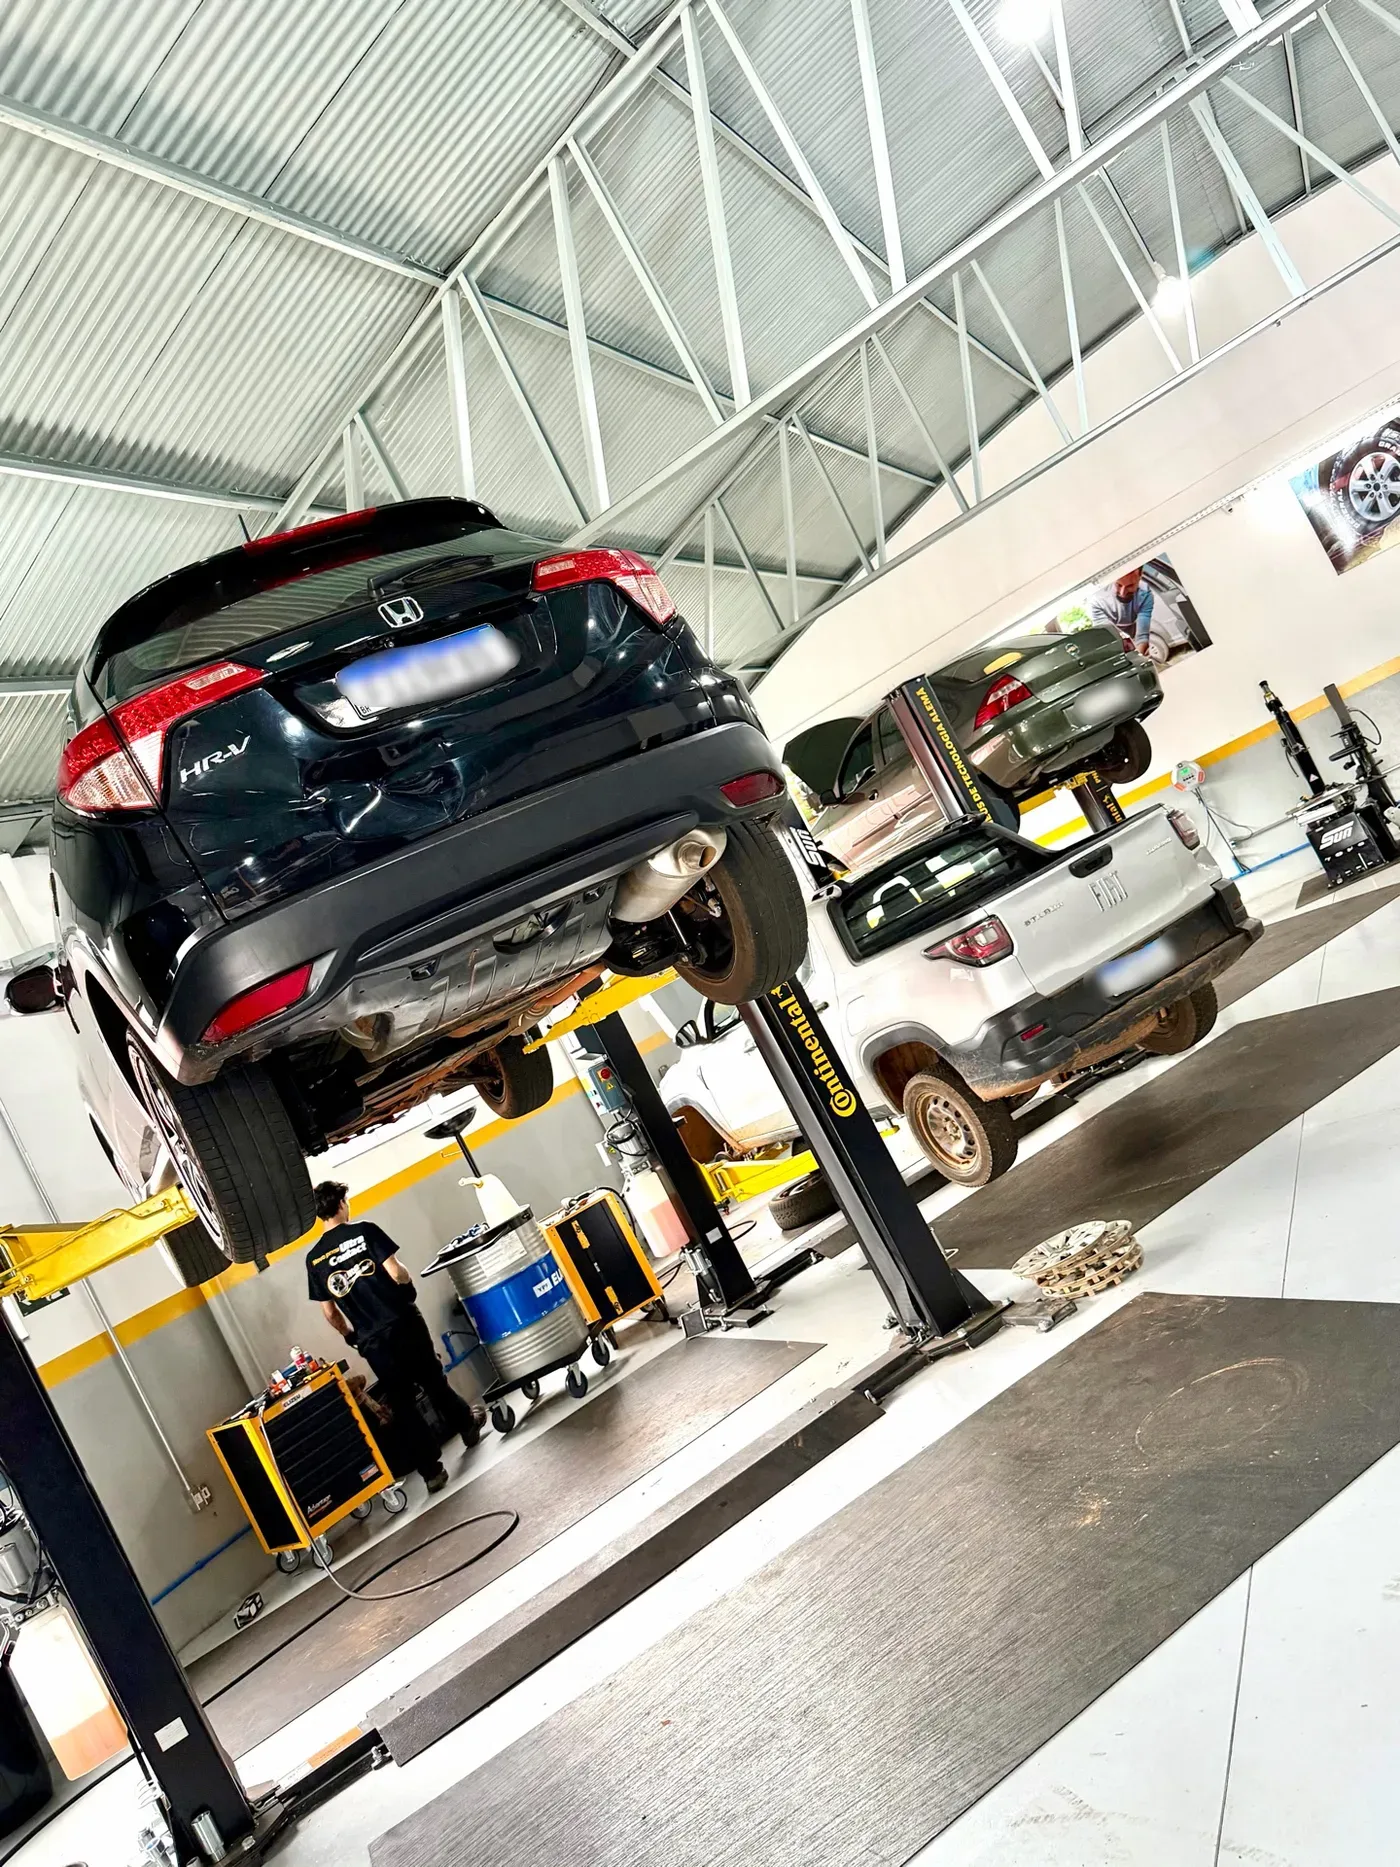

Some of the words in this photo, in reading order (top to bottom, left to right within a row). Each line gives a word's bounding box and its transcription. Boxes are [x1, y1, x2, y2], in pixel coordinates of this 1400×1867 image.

[915, 686, 941, 724] ALEMÃ
[179, 734, 251, 784] HR-V
[935, 723, 974, 789] TECNOLOGIA
[969, 785, 982, 802] DE
[1088, 870, 1129, 912] FIAT
[778, 993, 857, 1118] Continental
[329, 1242, 367, 1266] Contact
